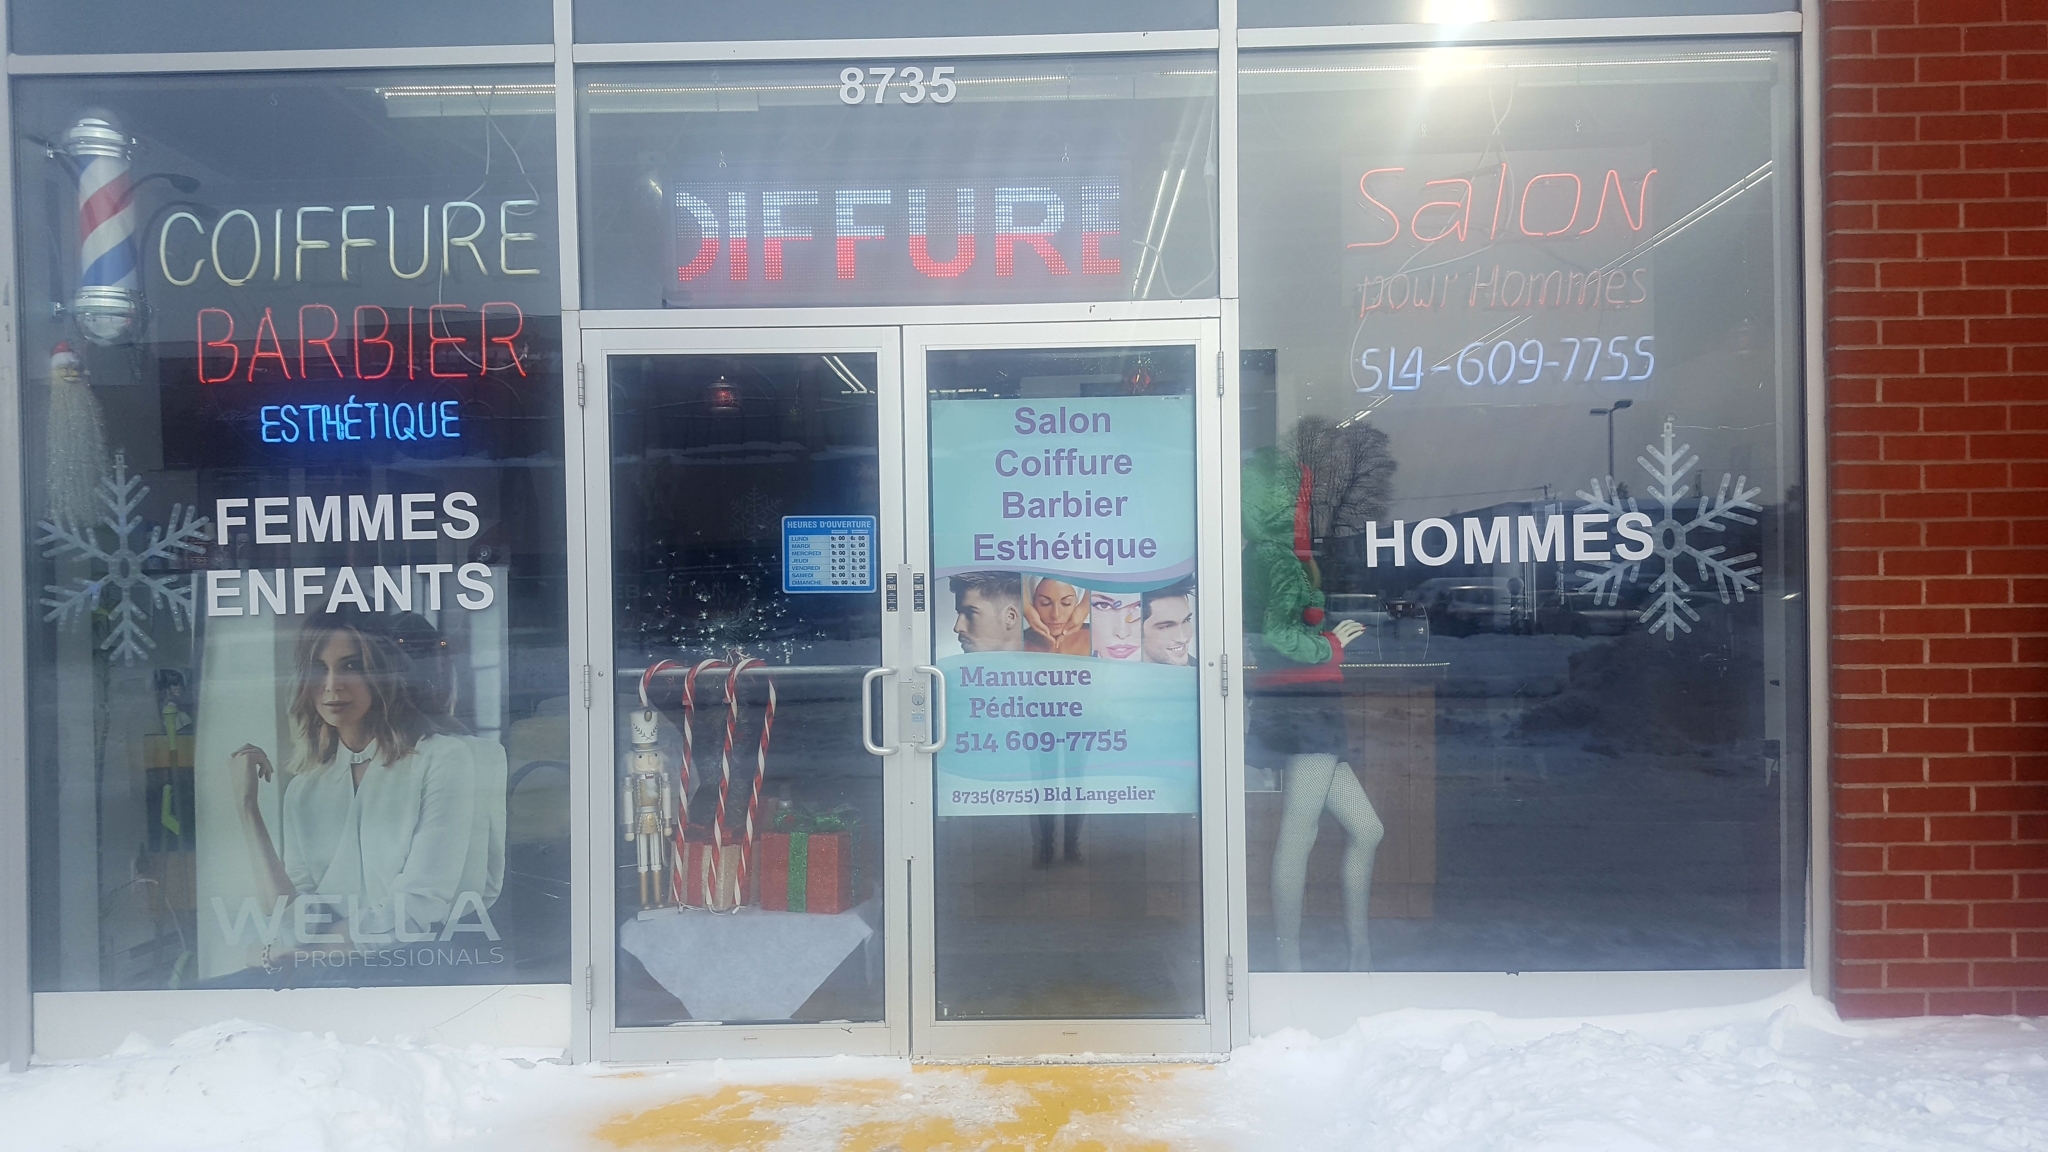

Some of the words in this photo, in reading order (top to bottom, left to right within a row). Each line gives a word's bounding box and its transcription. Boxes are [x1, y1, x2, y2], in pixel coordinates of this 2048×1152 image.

[839, 66, 957, 105] 8735
[159, 200, 541, 287] COIFFURE
[1359, 273, 1458, 318] pour
[1469, 265, 1647, 308] Hommes
[197, 302, 528, 385] BARBIER
[1356, 335, 1655, 393] 514-609-7755
[260, 395, 461, 444] ESTHÉTIQUE
[1014, 406, 1112, 434] Salon
[994, 448, 1133, 477] Coiffure
[216, 491, 480, 545] FEMMES
[1002, 490, 1128, 519] Barbier
[973, 532, 1157, 566] Esthétique
[1365, 512, 1655, 568] HOMMES
[206, 562, 495, 617] ENFANTS
[959, 666, 1092, 687] Manucure
[969, 696, 1083, 719] Pédicure
[954, 732, 999, 753] 514
[1005, 729, 1128, 753] 609-7755
[952, 787, 1040, 805] 8735(8755)
[1043, 786, 1072, 802] Bld
[1075, 785, 1156, 805] Langelier
[210, 891, 502, 947] WELLA
[294, 946, 505, 969] PROFESSIONALS
